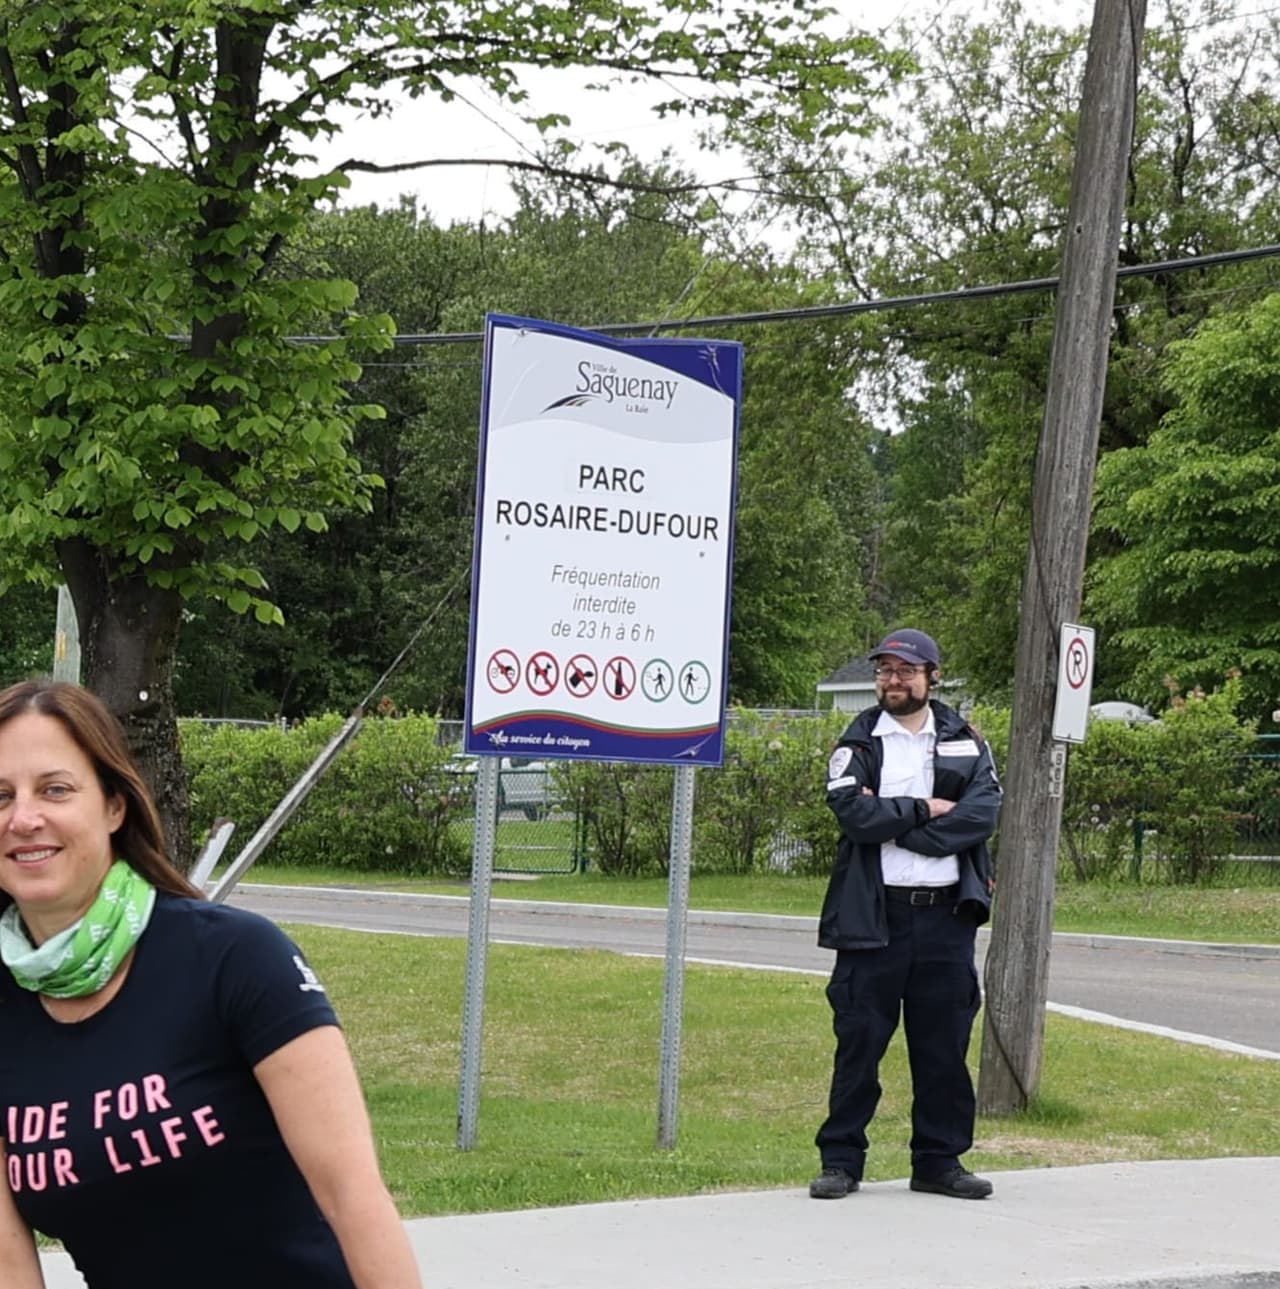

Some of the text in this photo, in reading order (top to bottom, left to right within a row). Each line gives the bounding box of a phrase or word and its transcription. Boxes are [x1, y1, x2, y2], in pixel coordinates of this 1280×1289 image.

[576, 361, 679, 409] Saguenay
[578, 464, 645, 495] PARC
[495, 499, 720, 541] ROSAIRE-DUFOUR
[551, 563, 661, 590] Fréquentation
[573, 592, 637, 616] interdite
[551, 618, 656, 643] de 23 h à 6 h
[7, 1073, 173, 1144] IDE FOR
[6, 1147, 80, 1193] OUR
